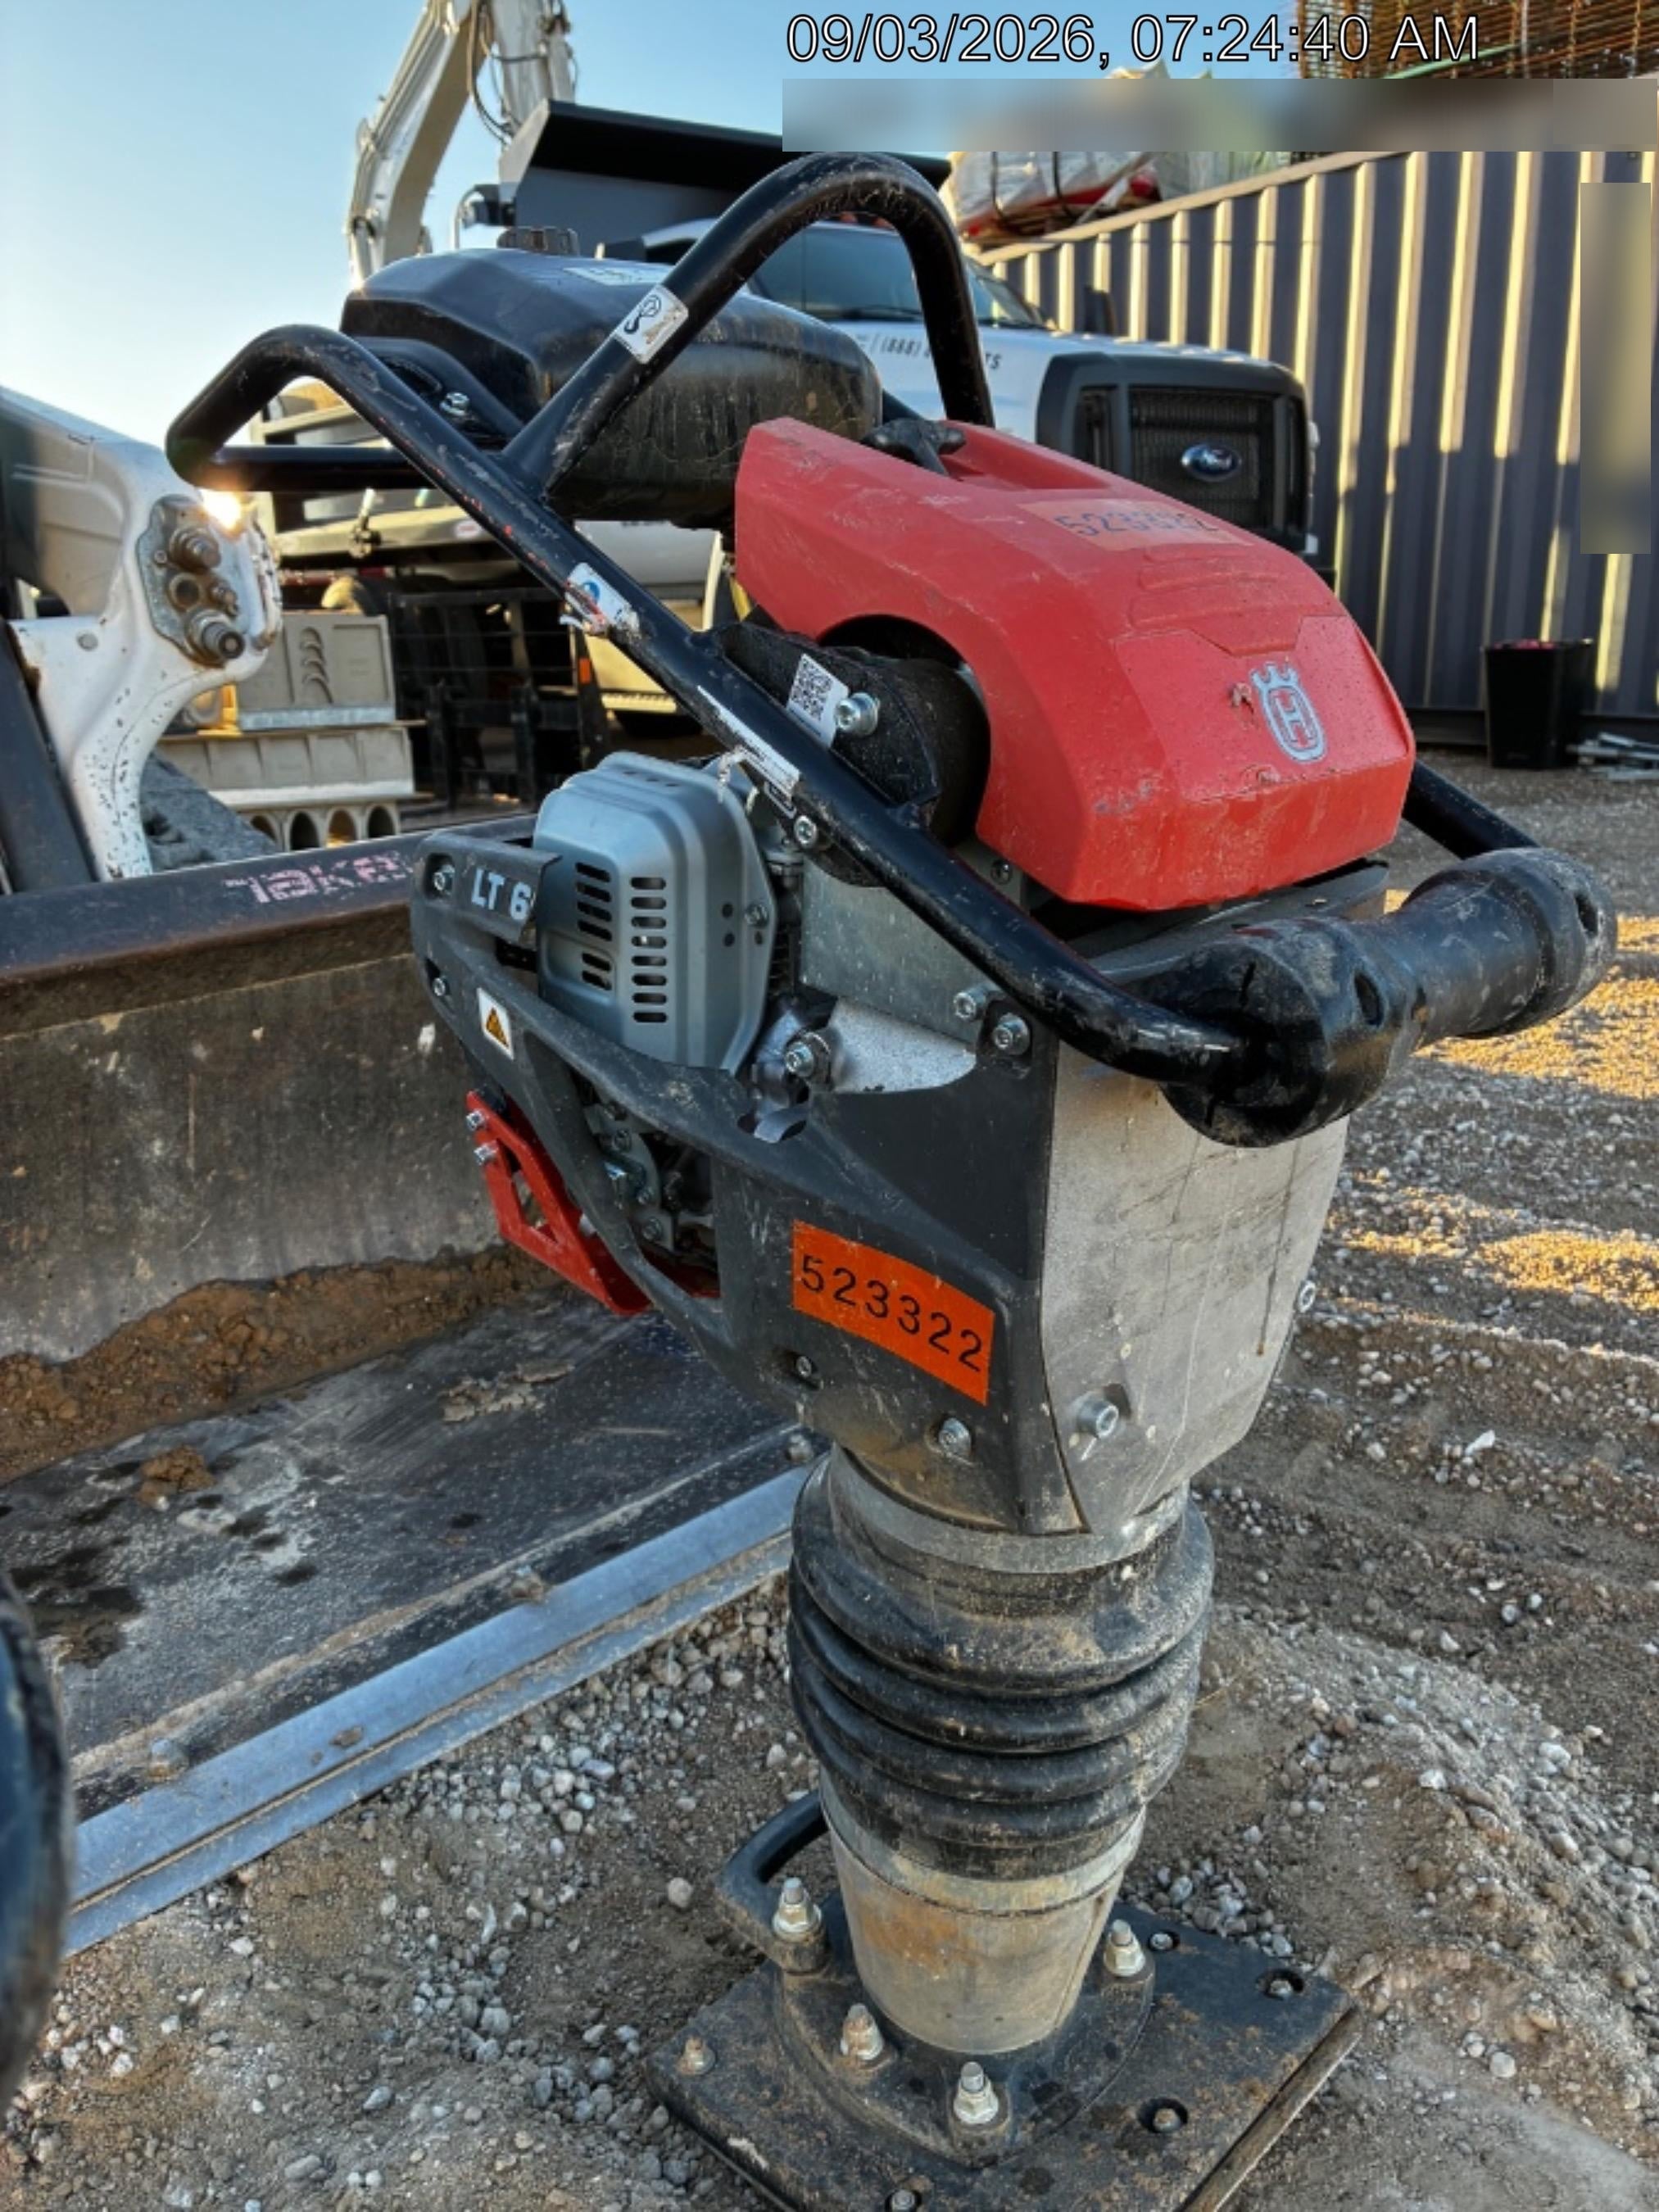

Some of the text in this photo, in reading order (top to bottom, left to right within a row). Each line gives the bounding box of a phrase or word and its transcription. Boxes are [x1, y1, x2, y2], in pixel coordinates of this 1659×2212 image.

[471, 867, 533, 921] LT 6
[801, 1254, 982, 1373] 523322
